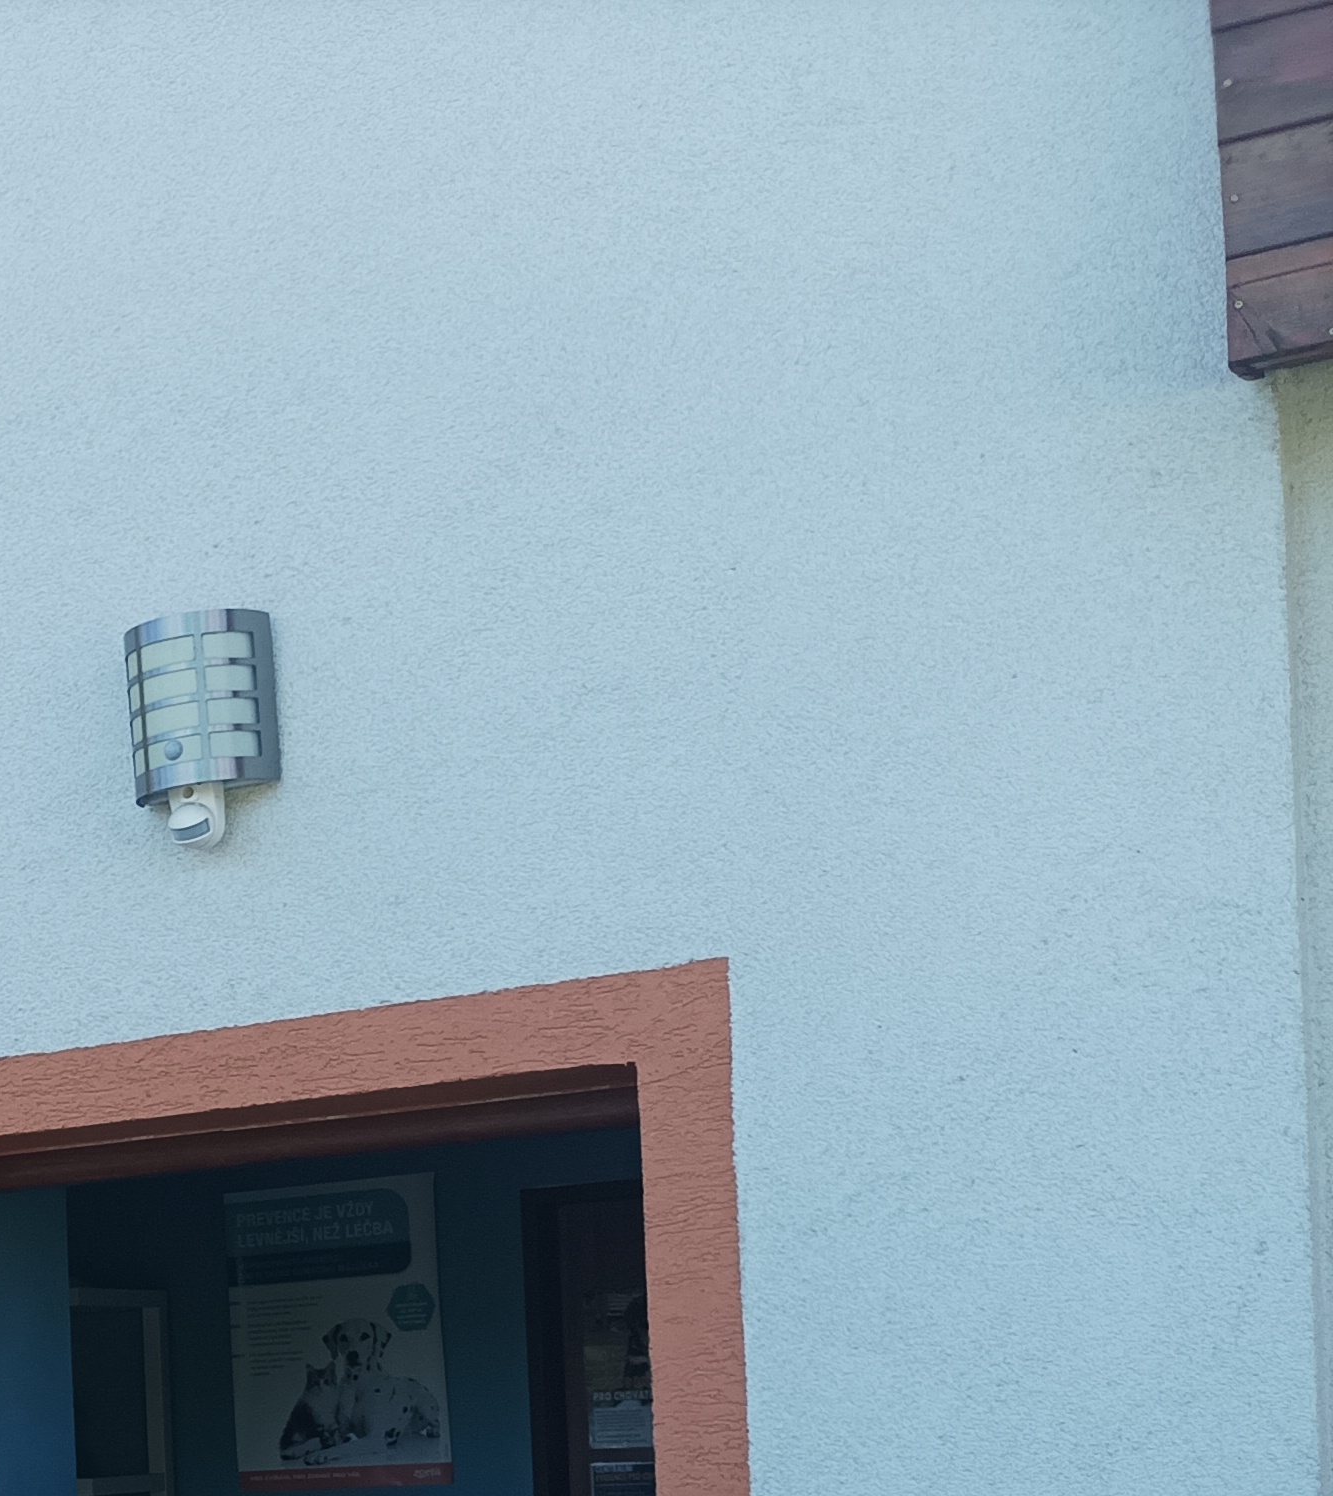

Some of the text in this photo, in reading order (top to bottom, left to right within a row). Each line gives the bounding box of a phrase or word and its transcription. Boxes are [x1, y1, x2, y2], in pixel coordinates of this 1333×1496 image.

[236, 1200, 374, 1228] PREVENCE JE VŽDY
[312, 1223, 341, 1242] NEŽ
[345, 1220, 394, 1239] LÉČBA
